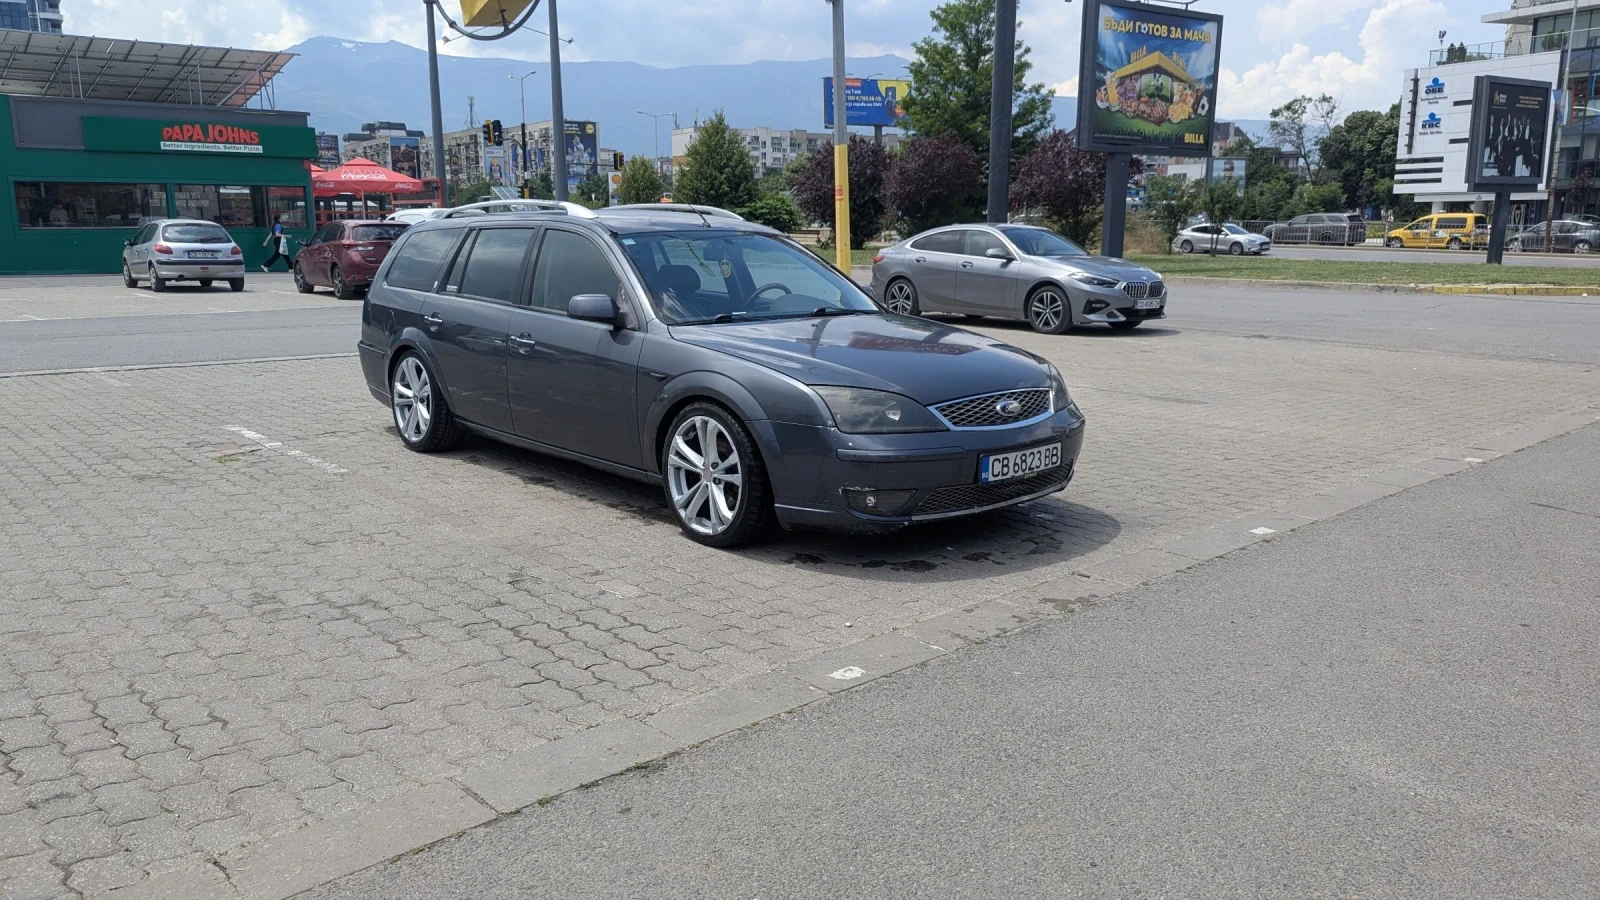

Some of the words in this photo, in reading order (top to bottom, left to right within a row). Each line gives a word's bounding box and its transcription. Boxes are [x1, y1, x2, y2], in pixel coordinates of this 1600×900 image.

[1104, 17, 1133, 33] БЪДИ
[1135, 21, 1168, 37] ГОТОВ
[1169, 26, 1182, 39] ЗА
[1184, 29, 1211, 44] МАЧА
[1130, 45, 1147, 62] BILLA
[162, 123, 206, 142] PAPA
[206, 123, 260, 144] JOHNS
[1184, 133, 1204, 144] BILLA
[184, 143, 222, 151] Ingredients.
[991, 456, 1010, 478] CB
[1013, 450, 1042, 474] 6823
[1044, 446, 1059, 468] BB
[981, 471, 989, 479] BG
